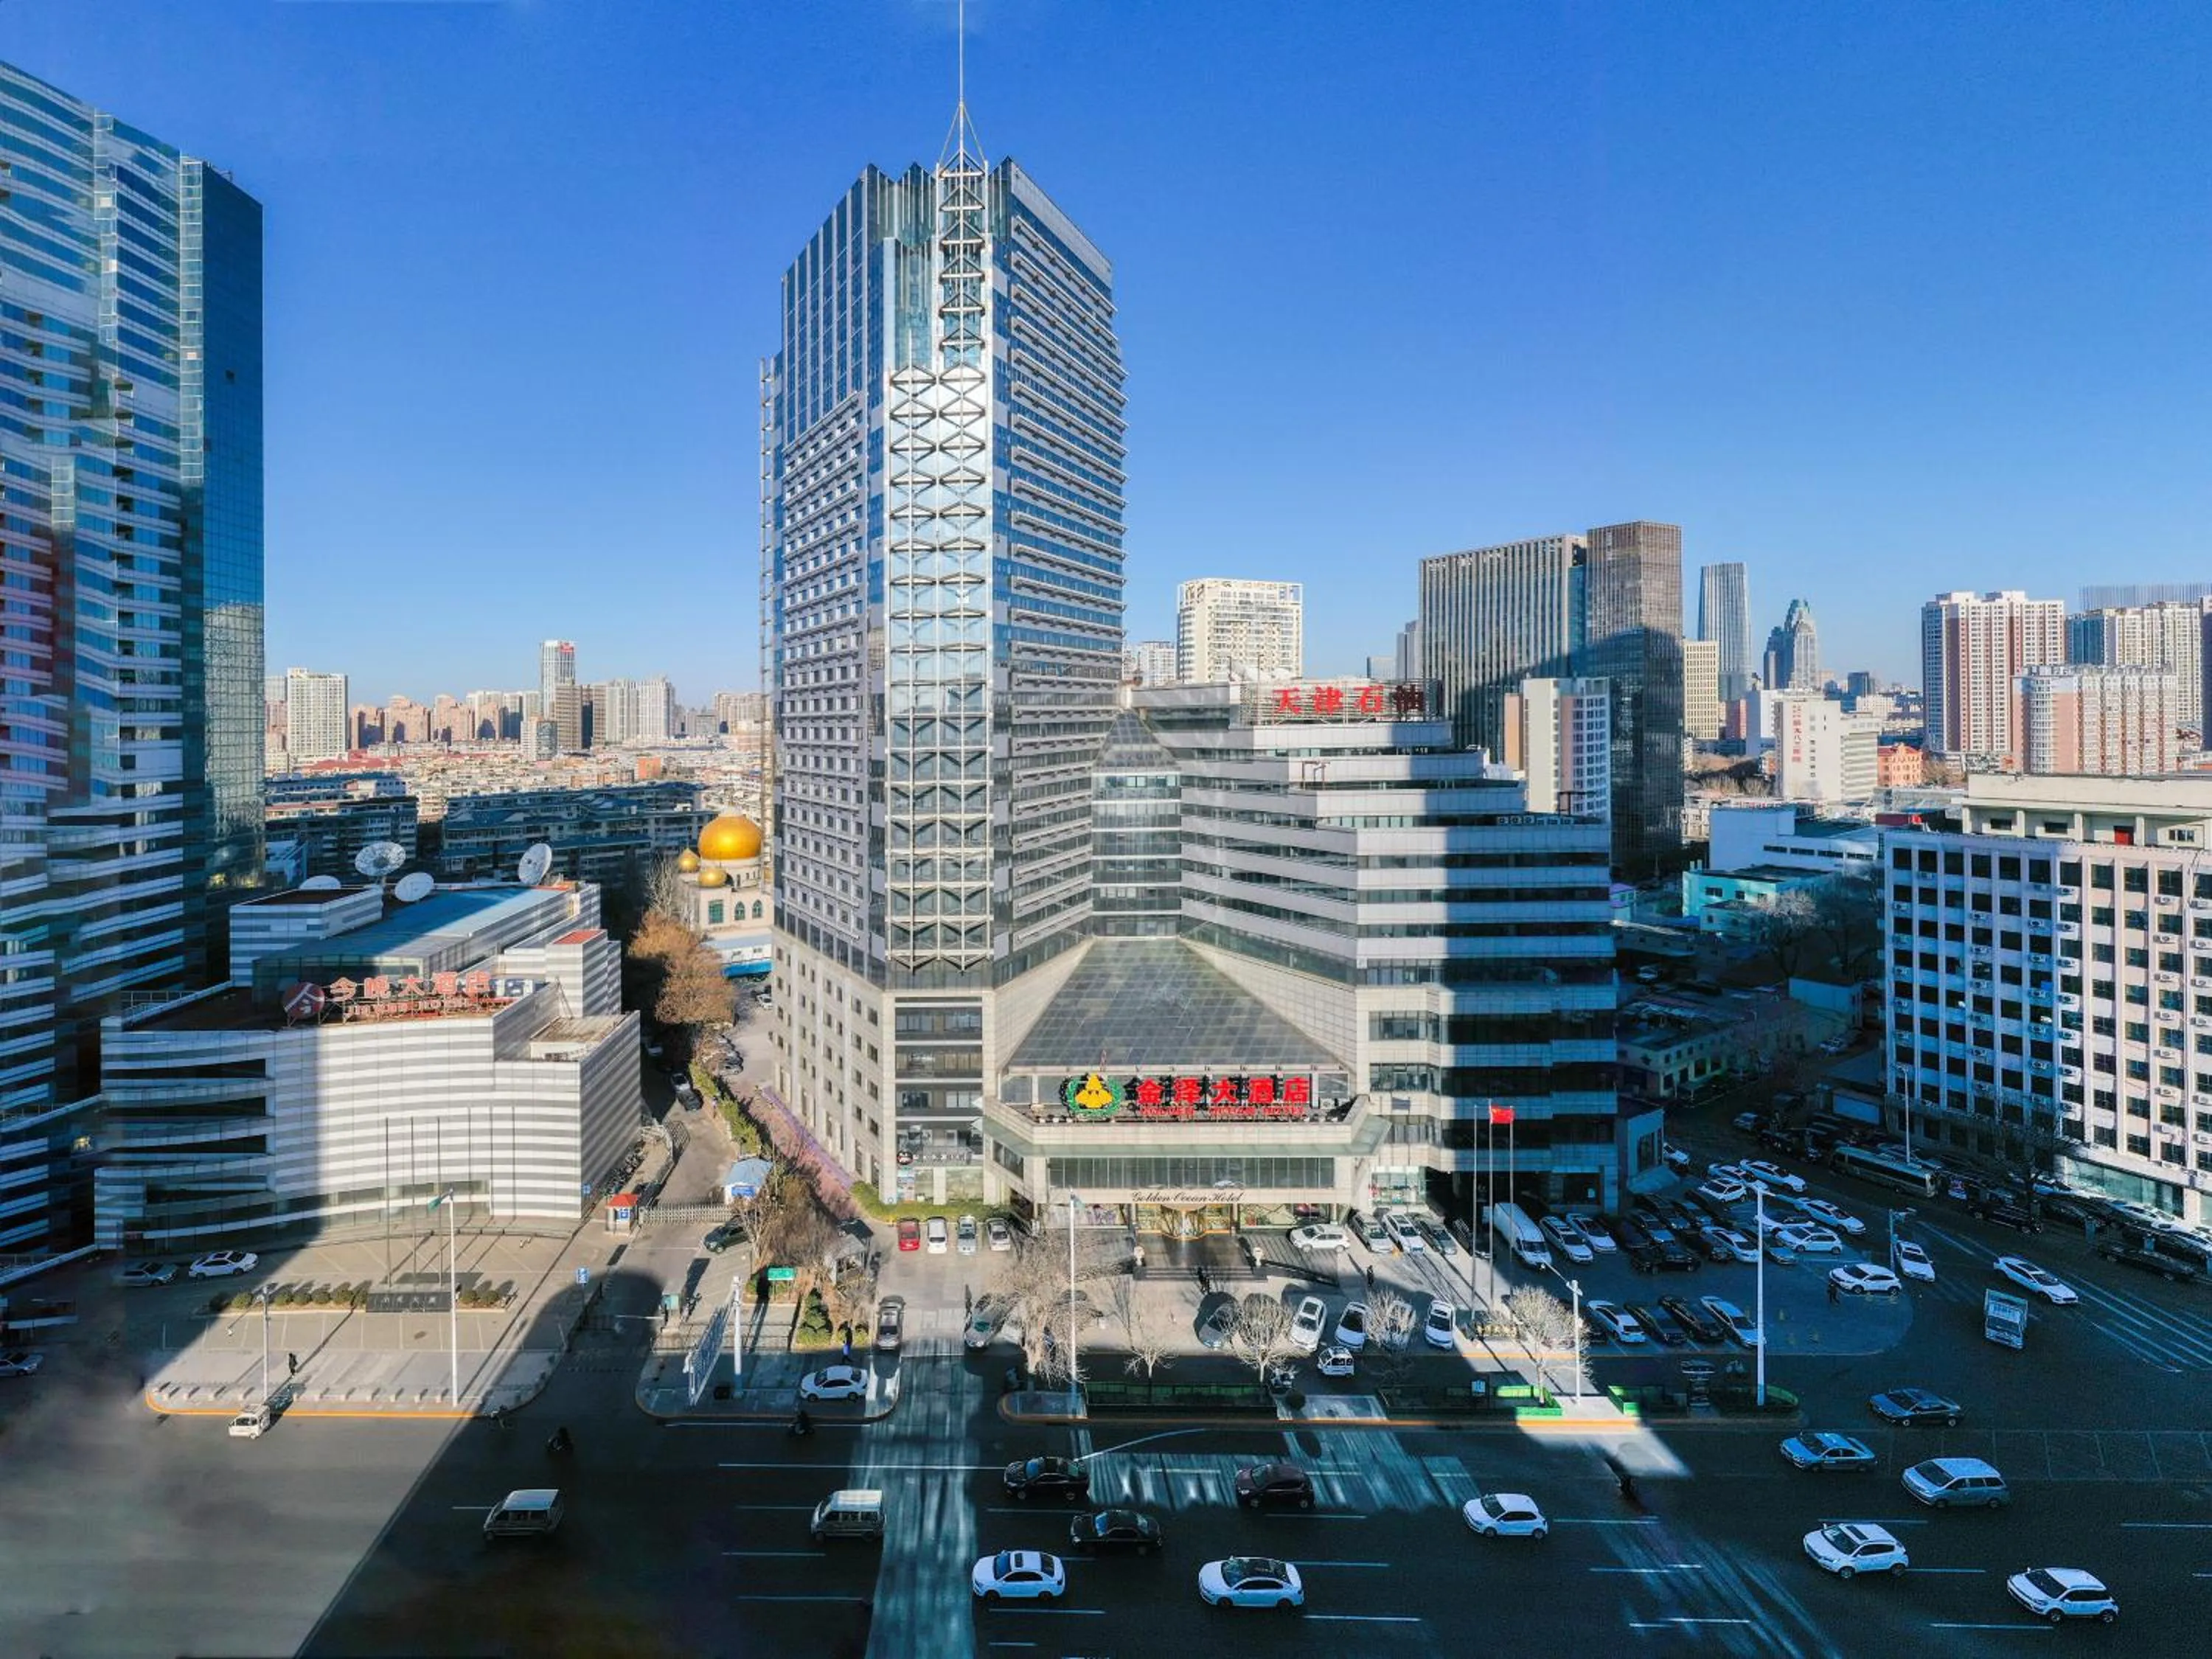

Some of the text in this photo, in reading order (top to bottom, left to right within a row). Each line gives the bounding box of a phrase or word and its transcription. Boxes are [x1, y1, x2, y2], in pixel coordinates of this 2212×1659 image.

[1273, 684, 1424, 717] 天津石油
[330, 970, 490, 1001] 今晚大酒店
[1136, 1077, 1310, 1104] 金泽大酒店
[1132, 1191, 1245, 1203] Golden Ocean Hotel
